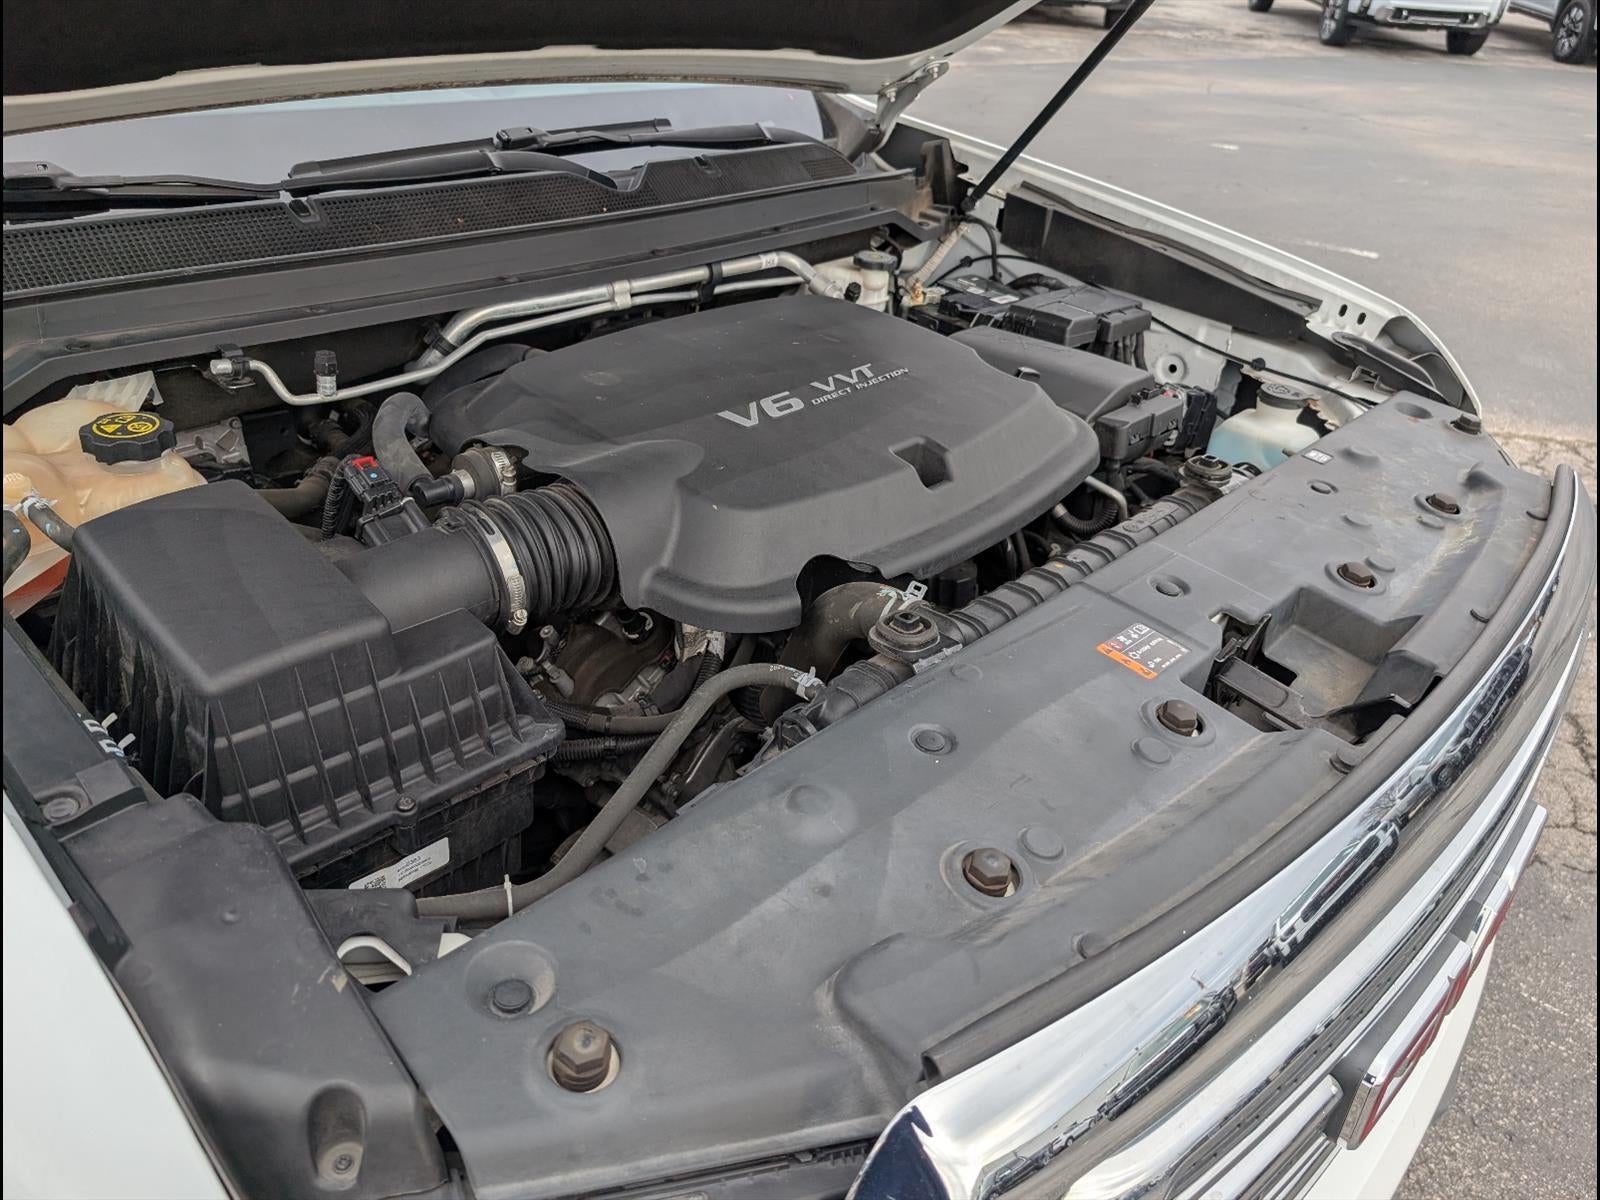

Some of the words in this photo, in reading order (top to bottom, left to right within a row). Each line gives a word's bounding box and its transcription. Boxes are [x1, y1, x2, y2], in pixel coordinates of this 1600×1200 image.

[717, 391, 805, 427] V6
[810, 364, 872, 391] VVT
[811, 387, 852, 405] DIRECT
[856, 367, 909, 390] INJECTION
